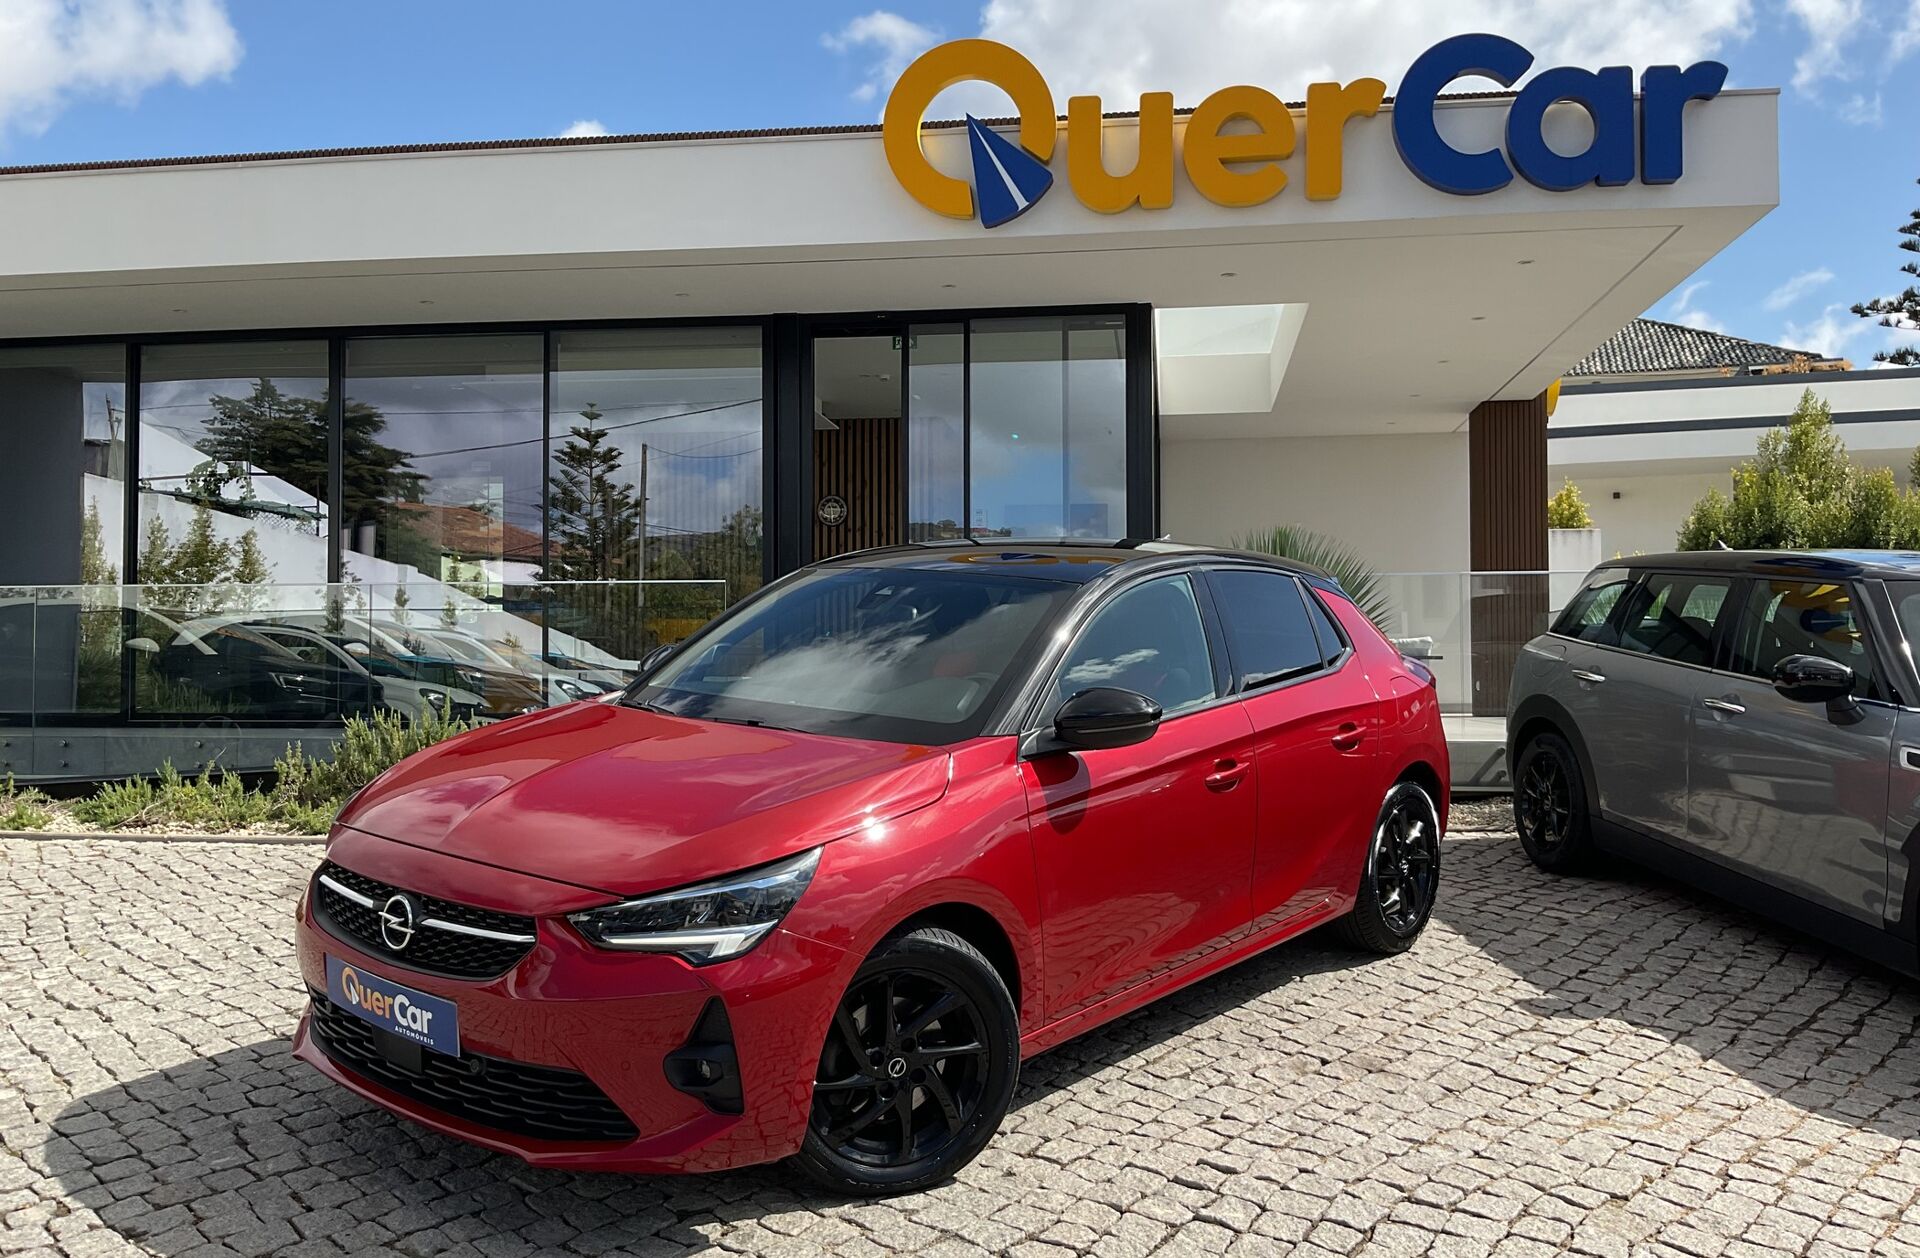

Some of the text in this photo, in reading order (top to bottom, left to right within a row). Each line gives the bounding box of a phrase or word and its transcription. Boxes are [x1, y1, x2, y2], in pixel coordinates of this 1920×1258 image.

[883, 33, 1728, 228] QuerCar
[342, 966, 433, 1034] QuerCar
[394, 1025, 434, 1045] AUTOMÓVEIS
